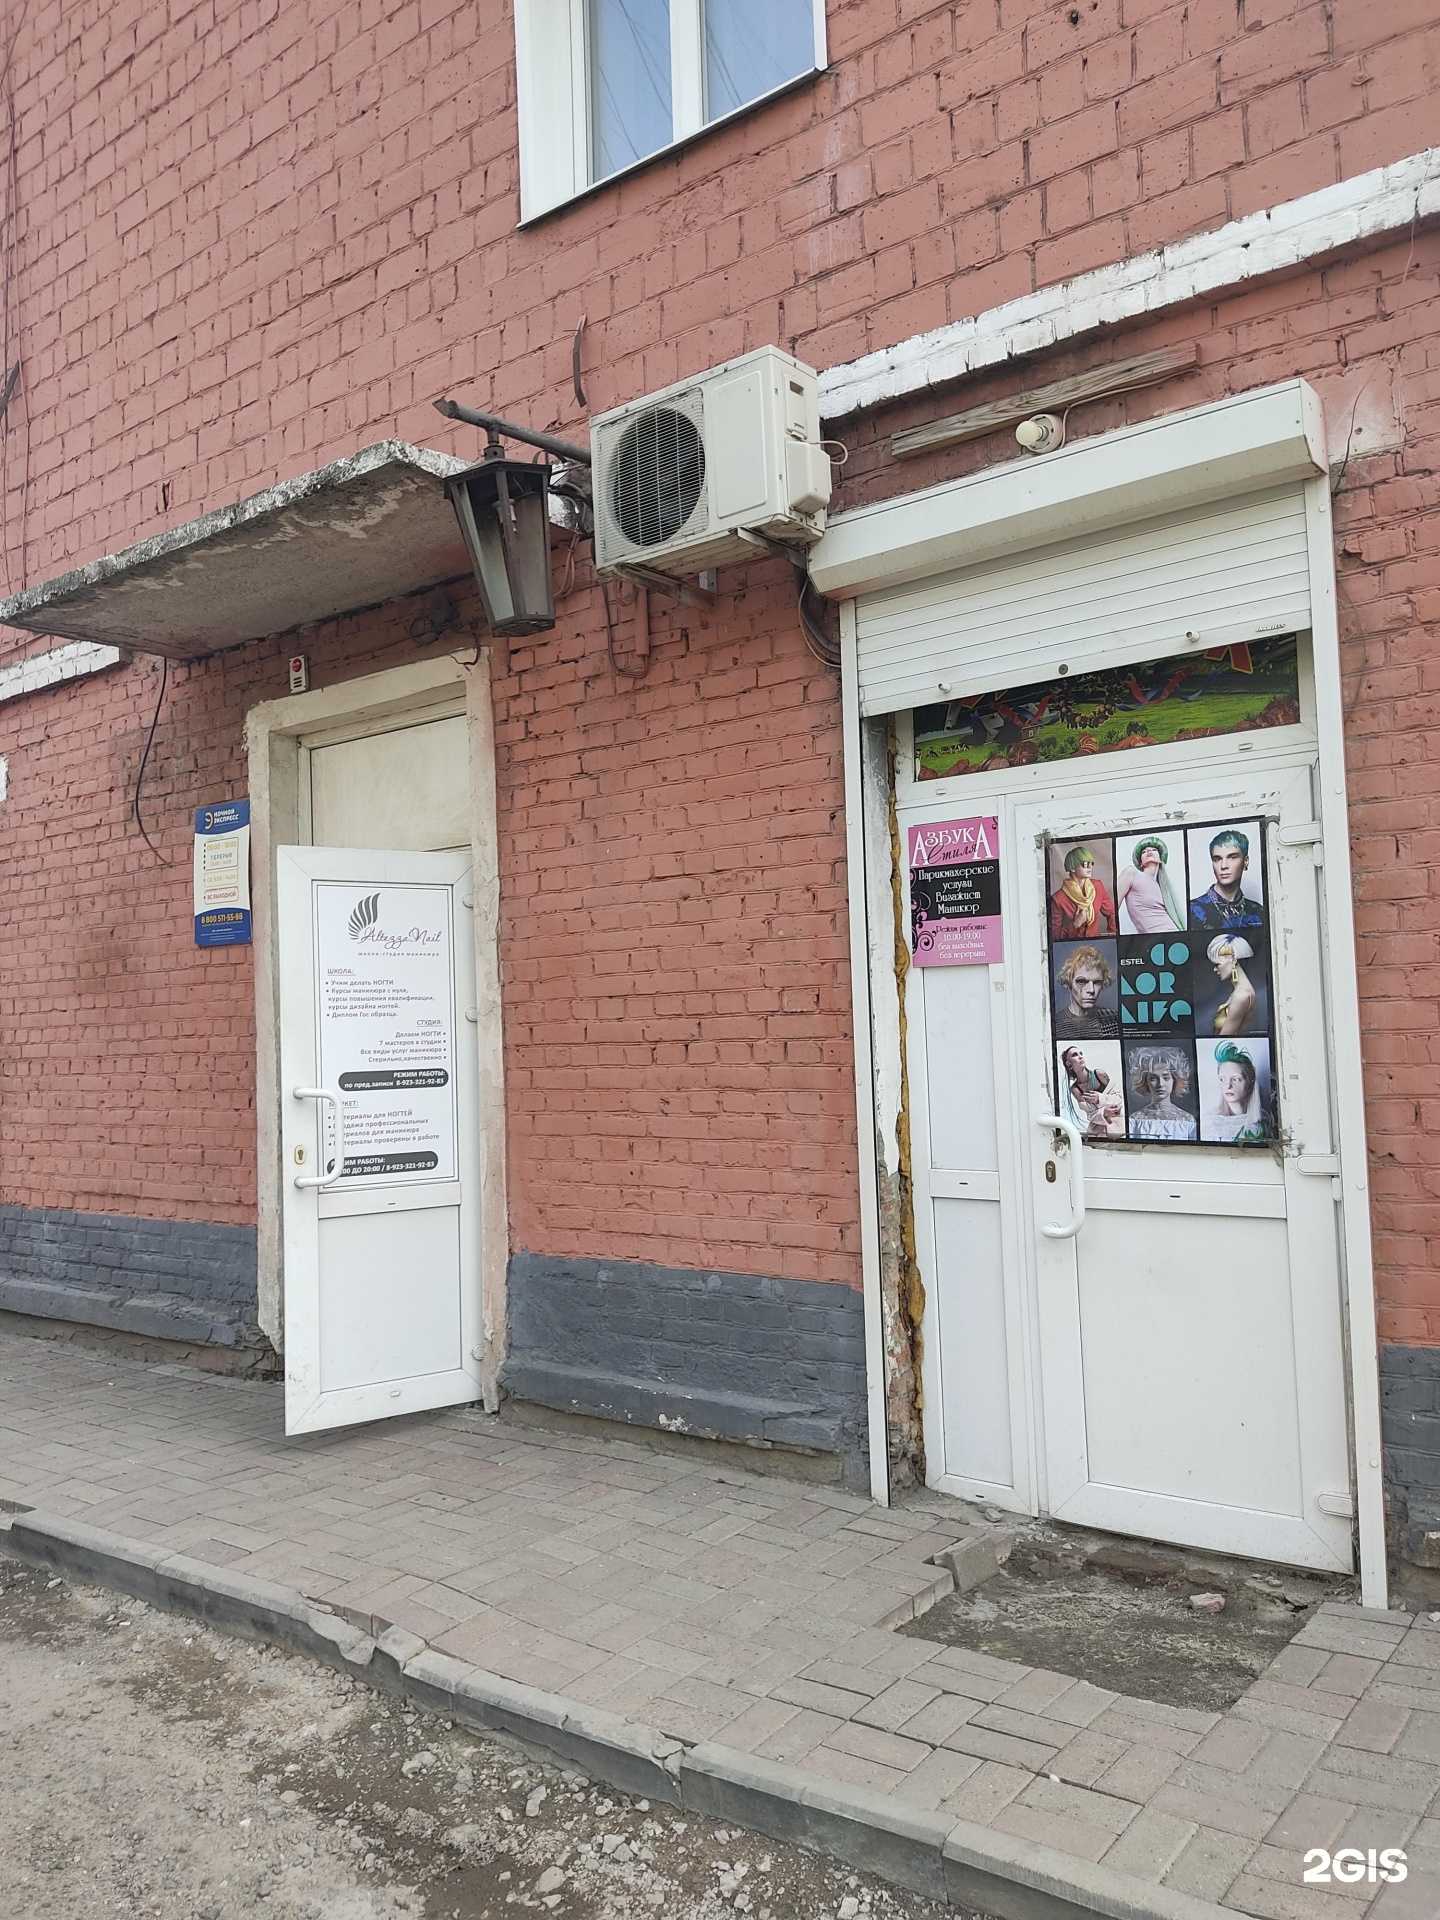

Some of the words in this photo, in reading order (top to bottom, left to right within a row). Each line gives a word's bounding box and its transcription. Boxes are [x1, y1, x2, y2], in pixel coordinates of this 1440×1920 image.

[214, 814, 239, 824] ЭКСПРЕСС
[928, 842, 976, 864] Стиля
[918, 865, 994, 882] Парикмахерские
[942, 879, 972, 893] услуги
[936, 890, 980, 902] Визажист
[938, 903, 980, 914] Маникюр
